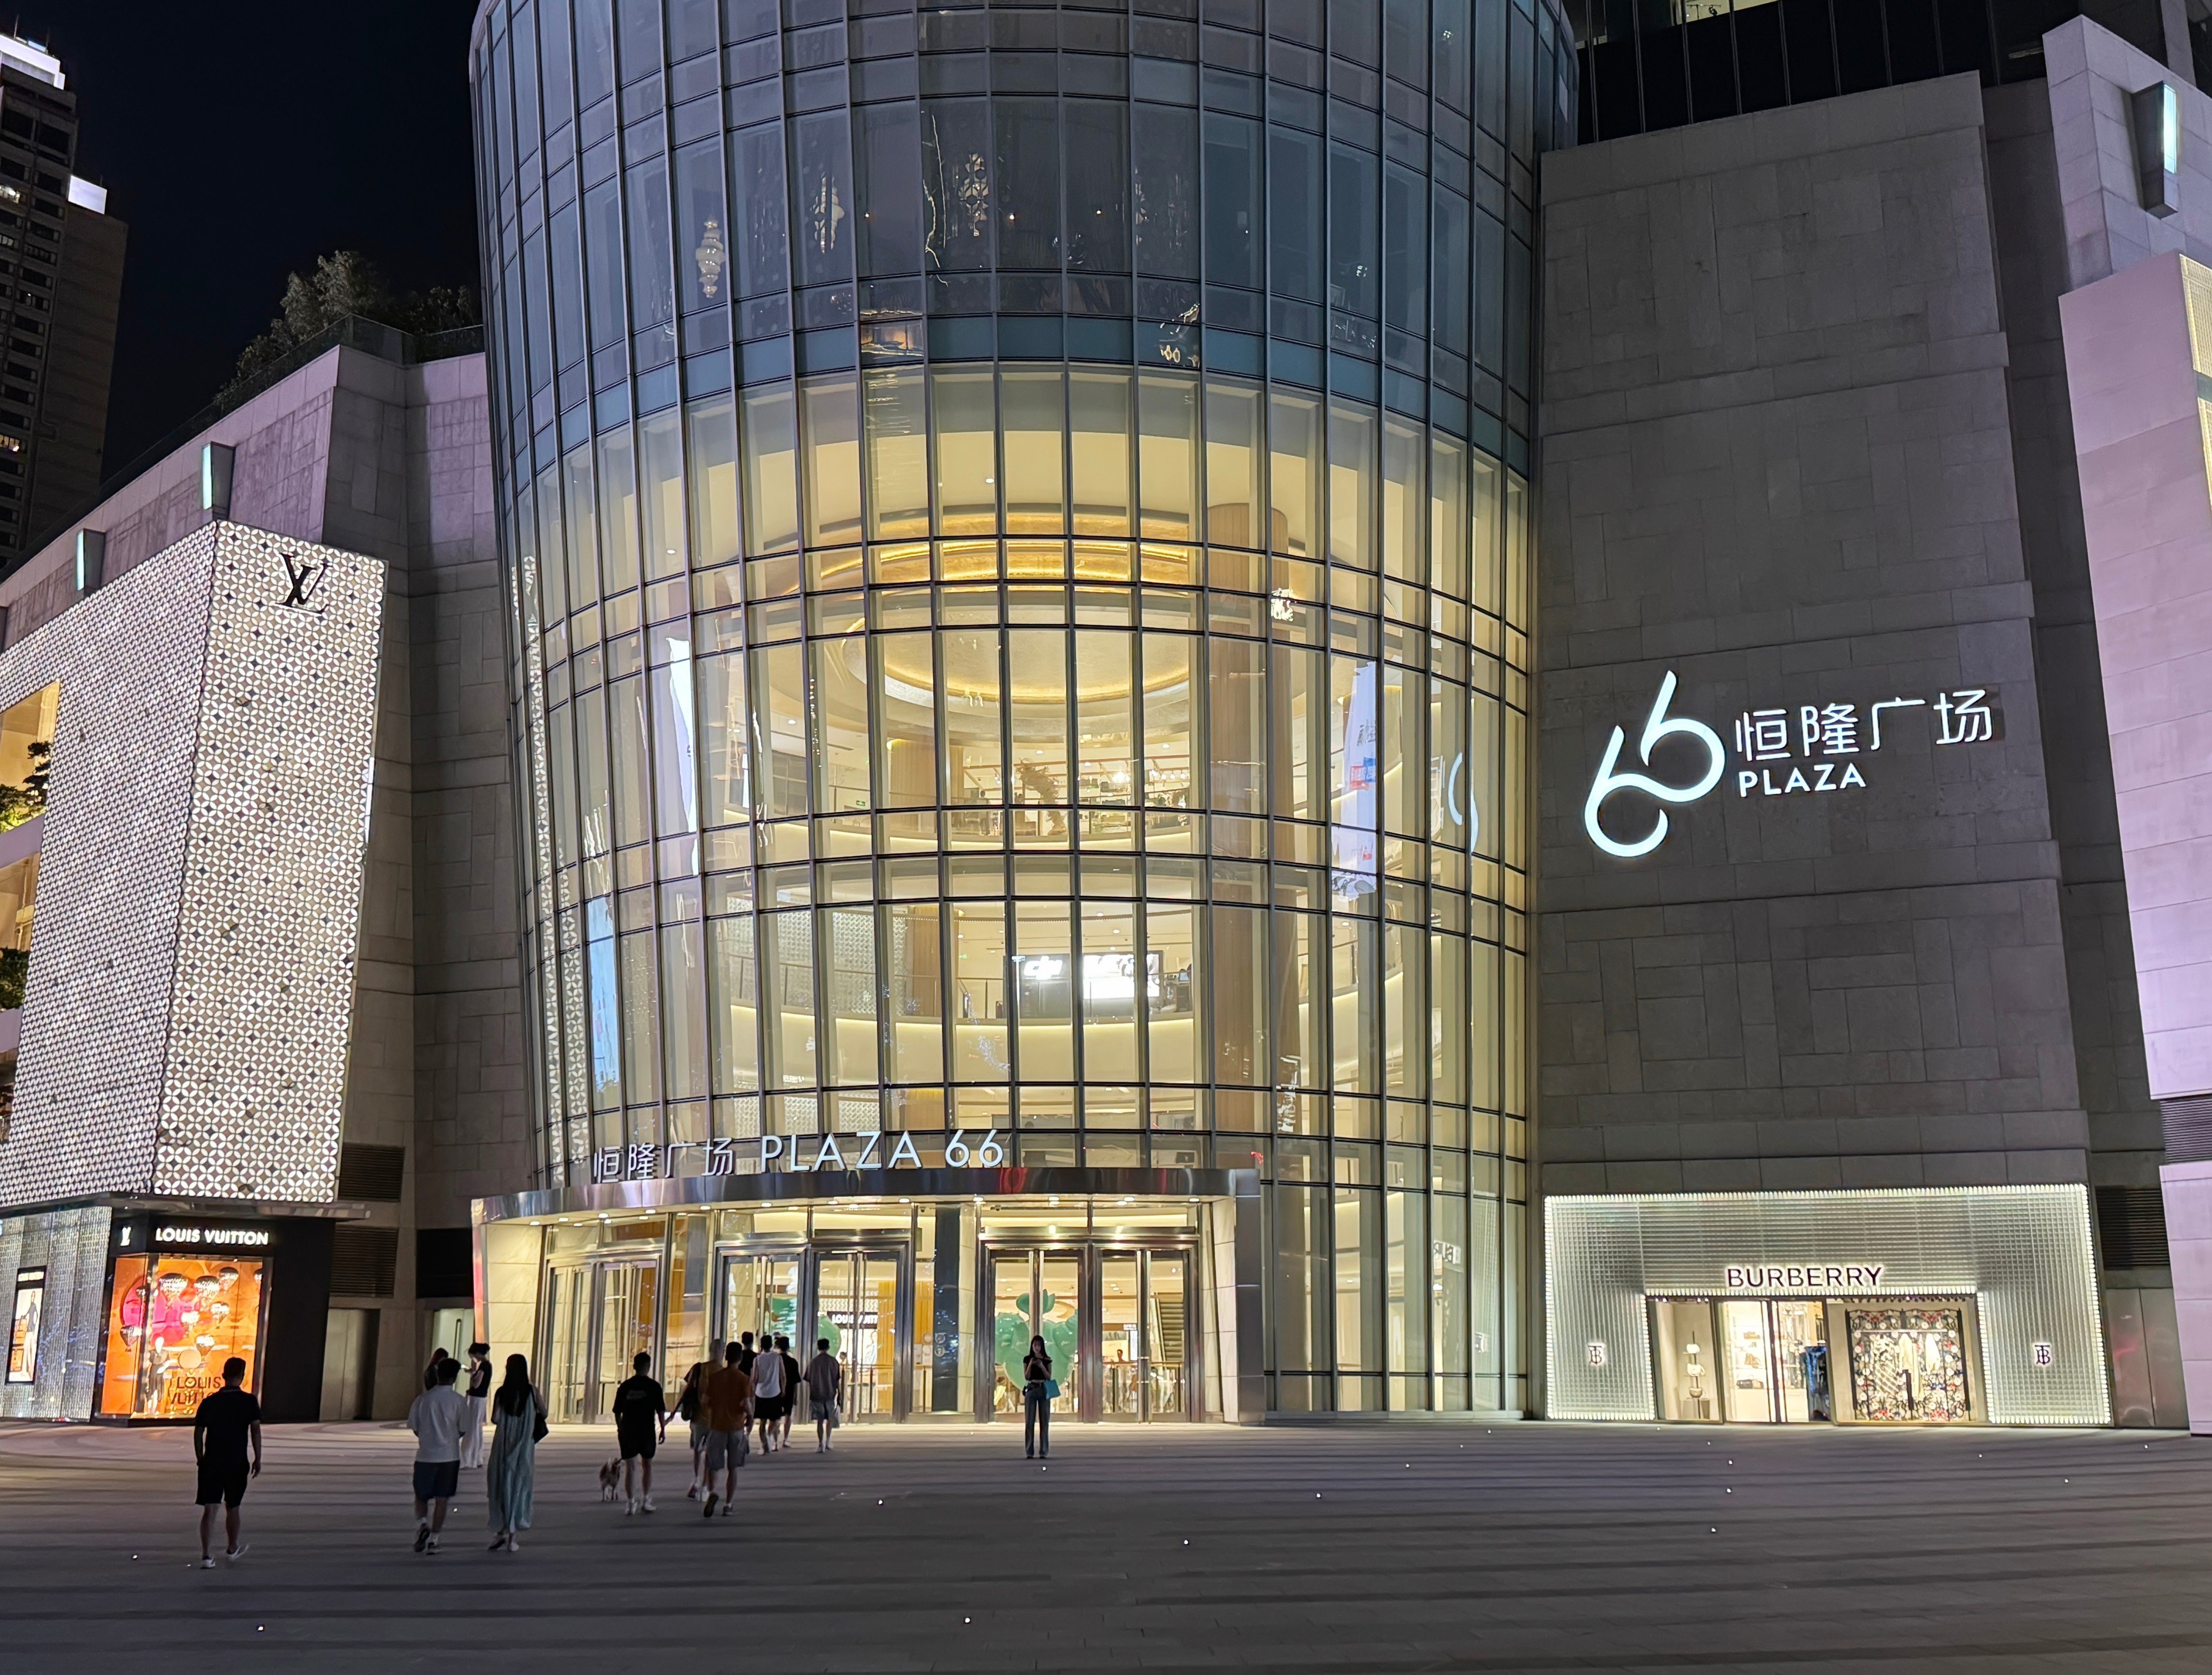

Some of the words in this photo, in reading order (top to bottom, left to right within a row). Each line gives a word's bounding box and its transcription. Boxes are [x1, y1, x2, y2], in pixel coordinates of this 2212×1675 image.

[1735, 689, 1993, 761] 恒隆广场
[1738, 762, 1867, 798] PLAZA
[594, 1137, 733, 1183] 恒隆广场
[761, 1129, 922, 1172] PLAZA
[945, 1129, 1004, 1168] 66
[156, 1228, 200, 1242] LOUIS
[205, 1229, 268, 1245] VUITTON
[1728, 1267, 1882, 1287] BURBERRY
[177, 1376, 221, 1389] LOUIS
